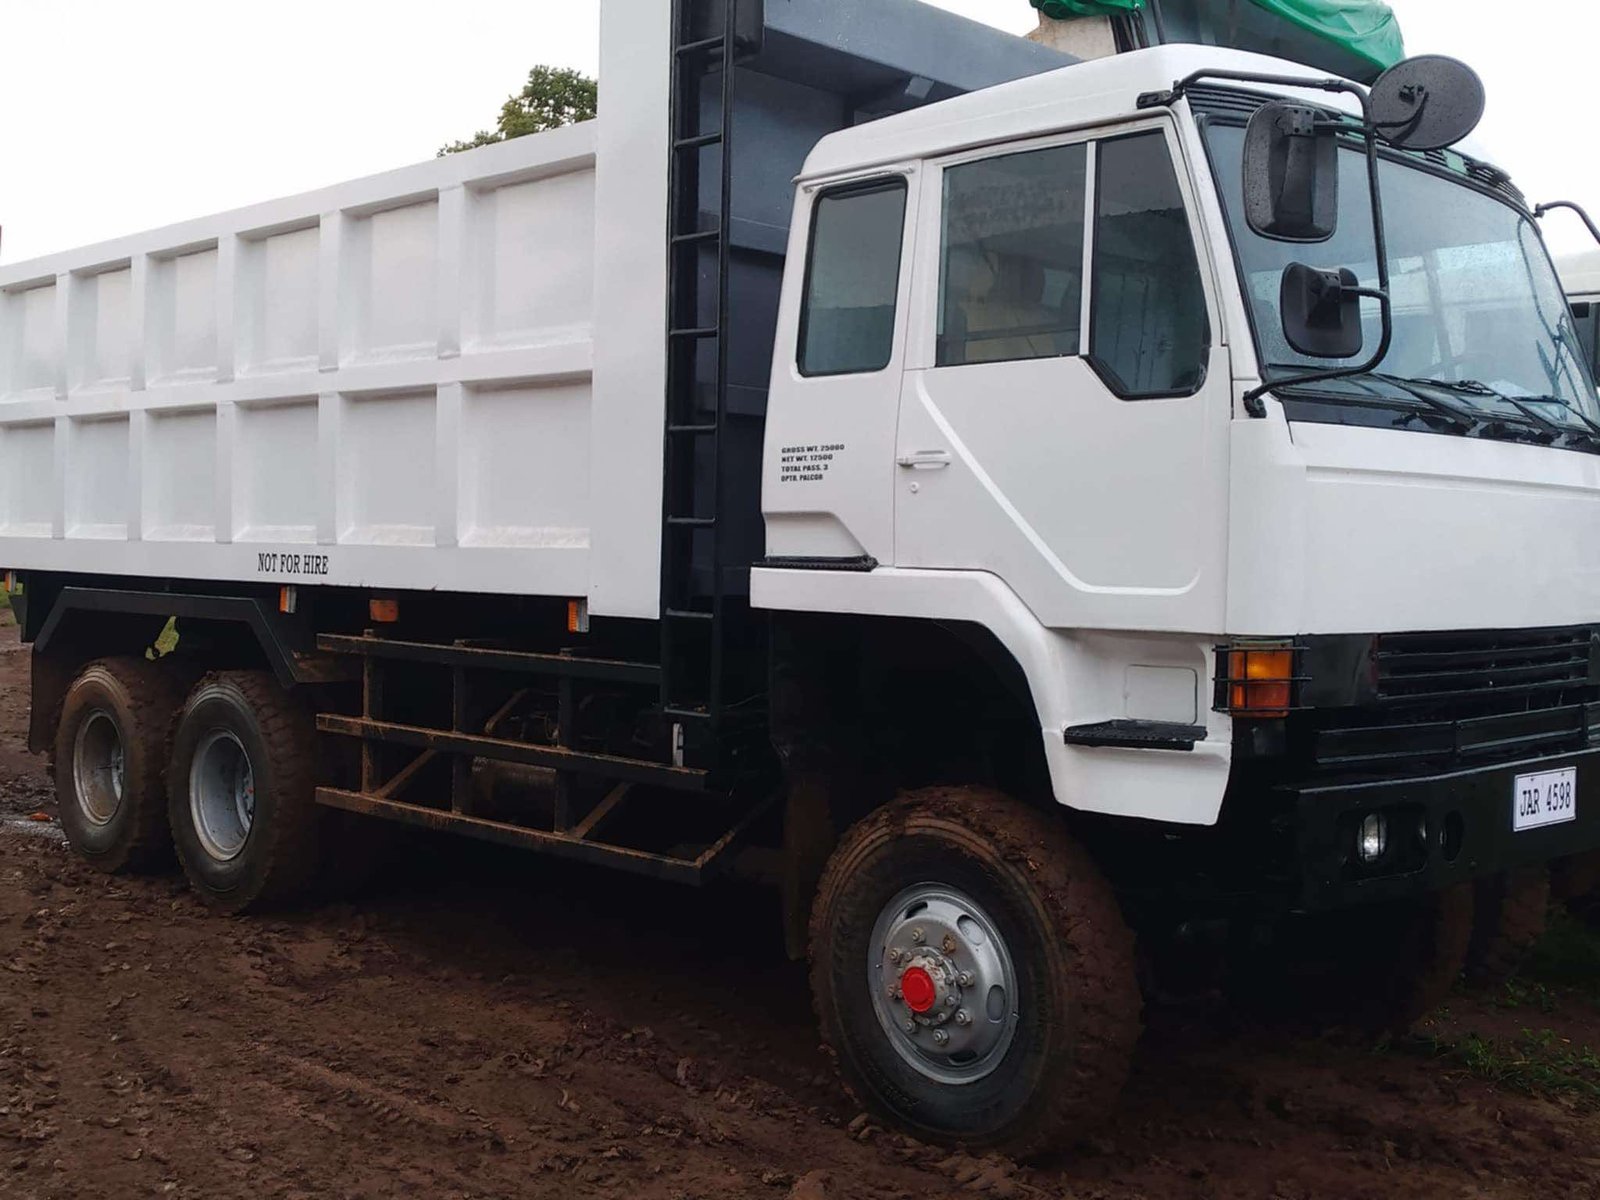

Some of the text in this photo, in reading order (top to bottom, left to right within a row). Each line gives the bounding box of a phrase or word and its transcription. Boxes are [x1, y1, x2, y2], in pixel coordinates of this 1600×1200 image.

[820, 444, 845, 452] 25000
[258, 553, 329, 575] NOT FOR HIRE
[1520, 781, 1571, 816] JAR 4598
